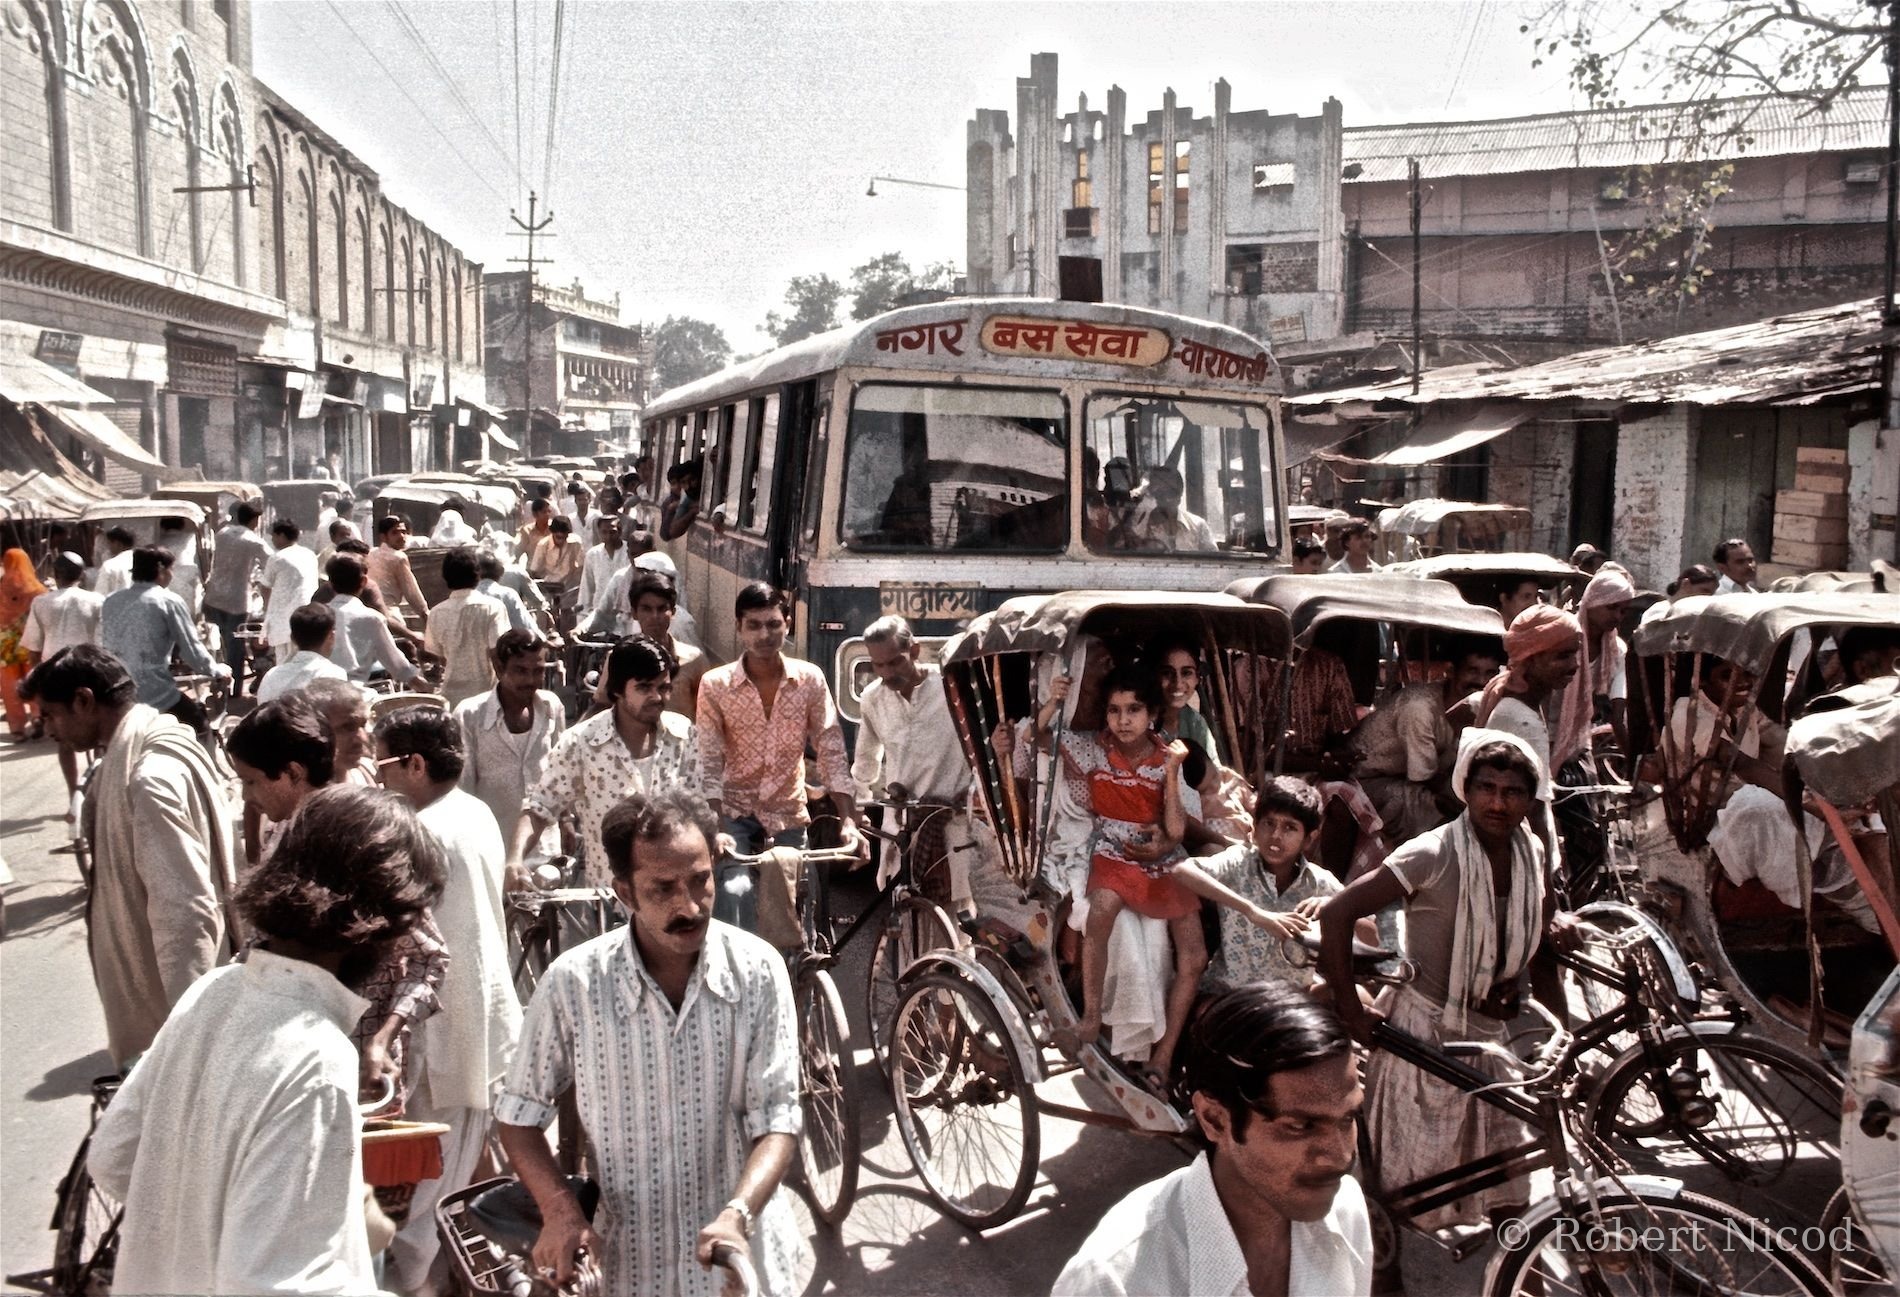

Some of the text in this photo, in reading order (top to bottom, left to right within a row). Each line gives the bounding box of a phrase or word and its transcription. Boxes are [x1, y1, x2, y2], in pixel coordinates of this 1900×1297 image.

[875, 318, 969, 357] नगर
[993, 322, 1059, 352] बस
[1064, 320, 1148, 358] सेवा
